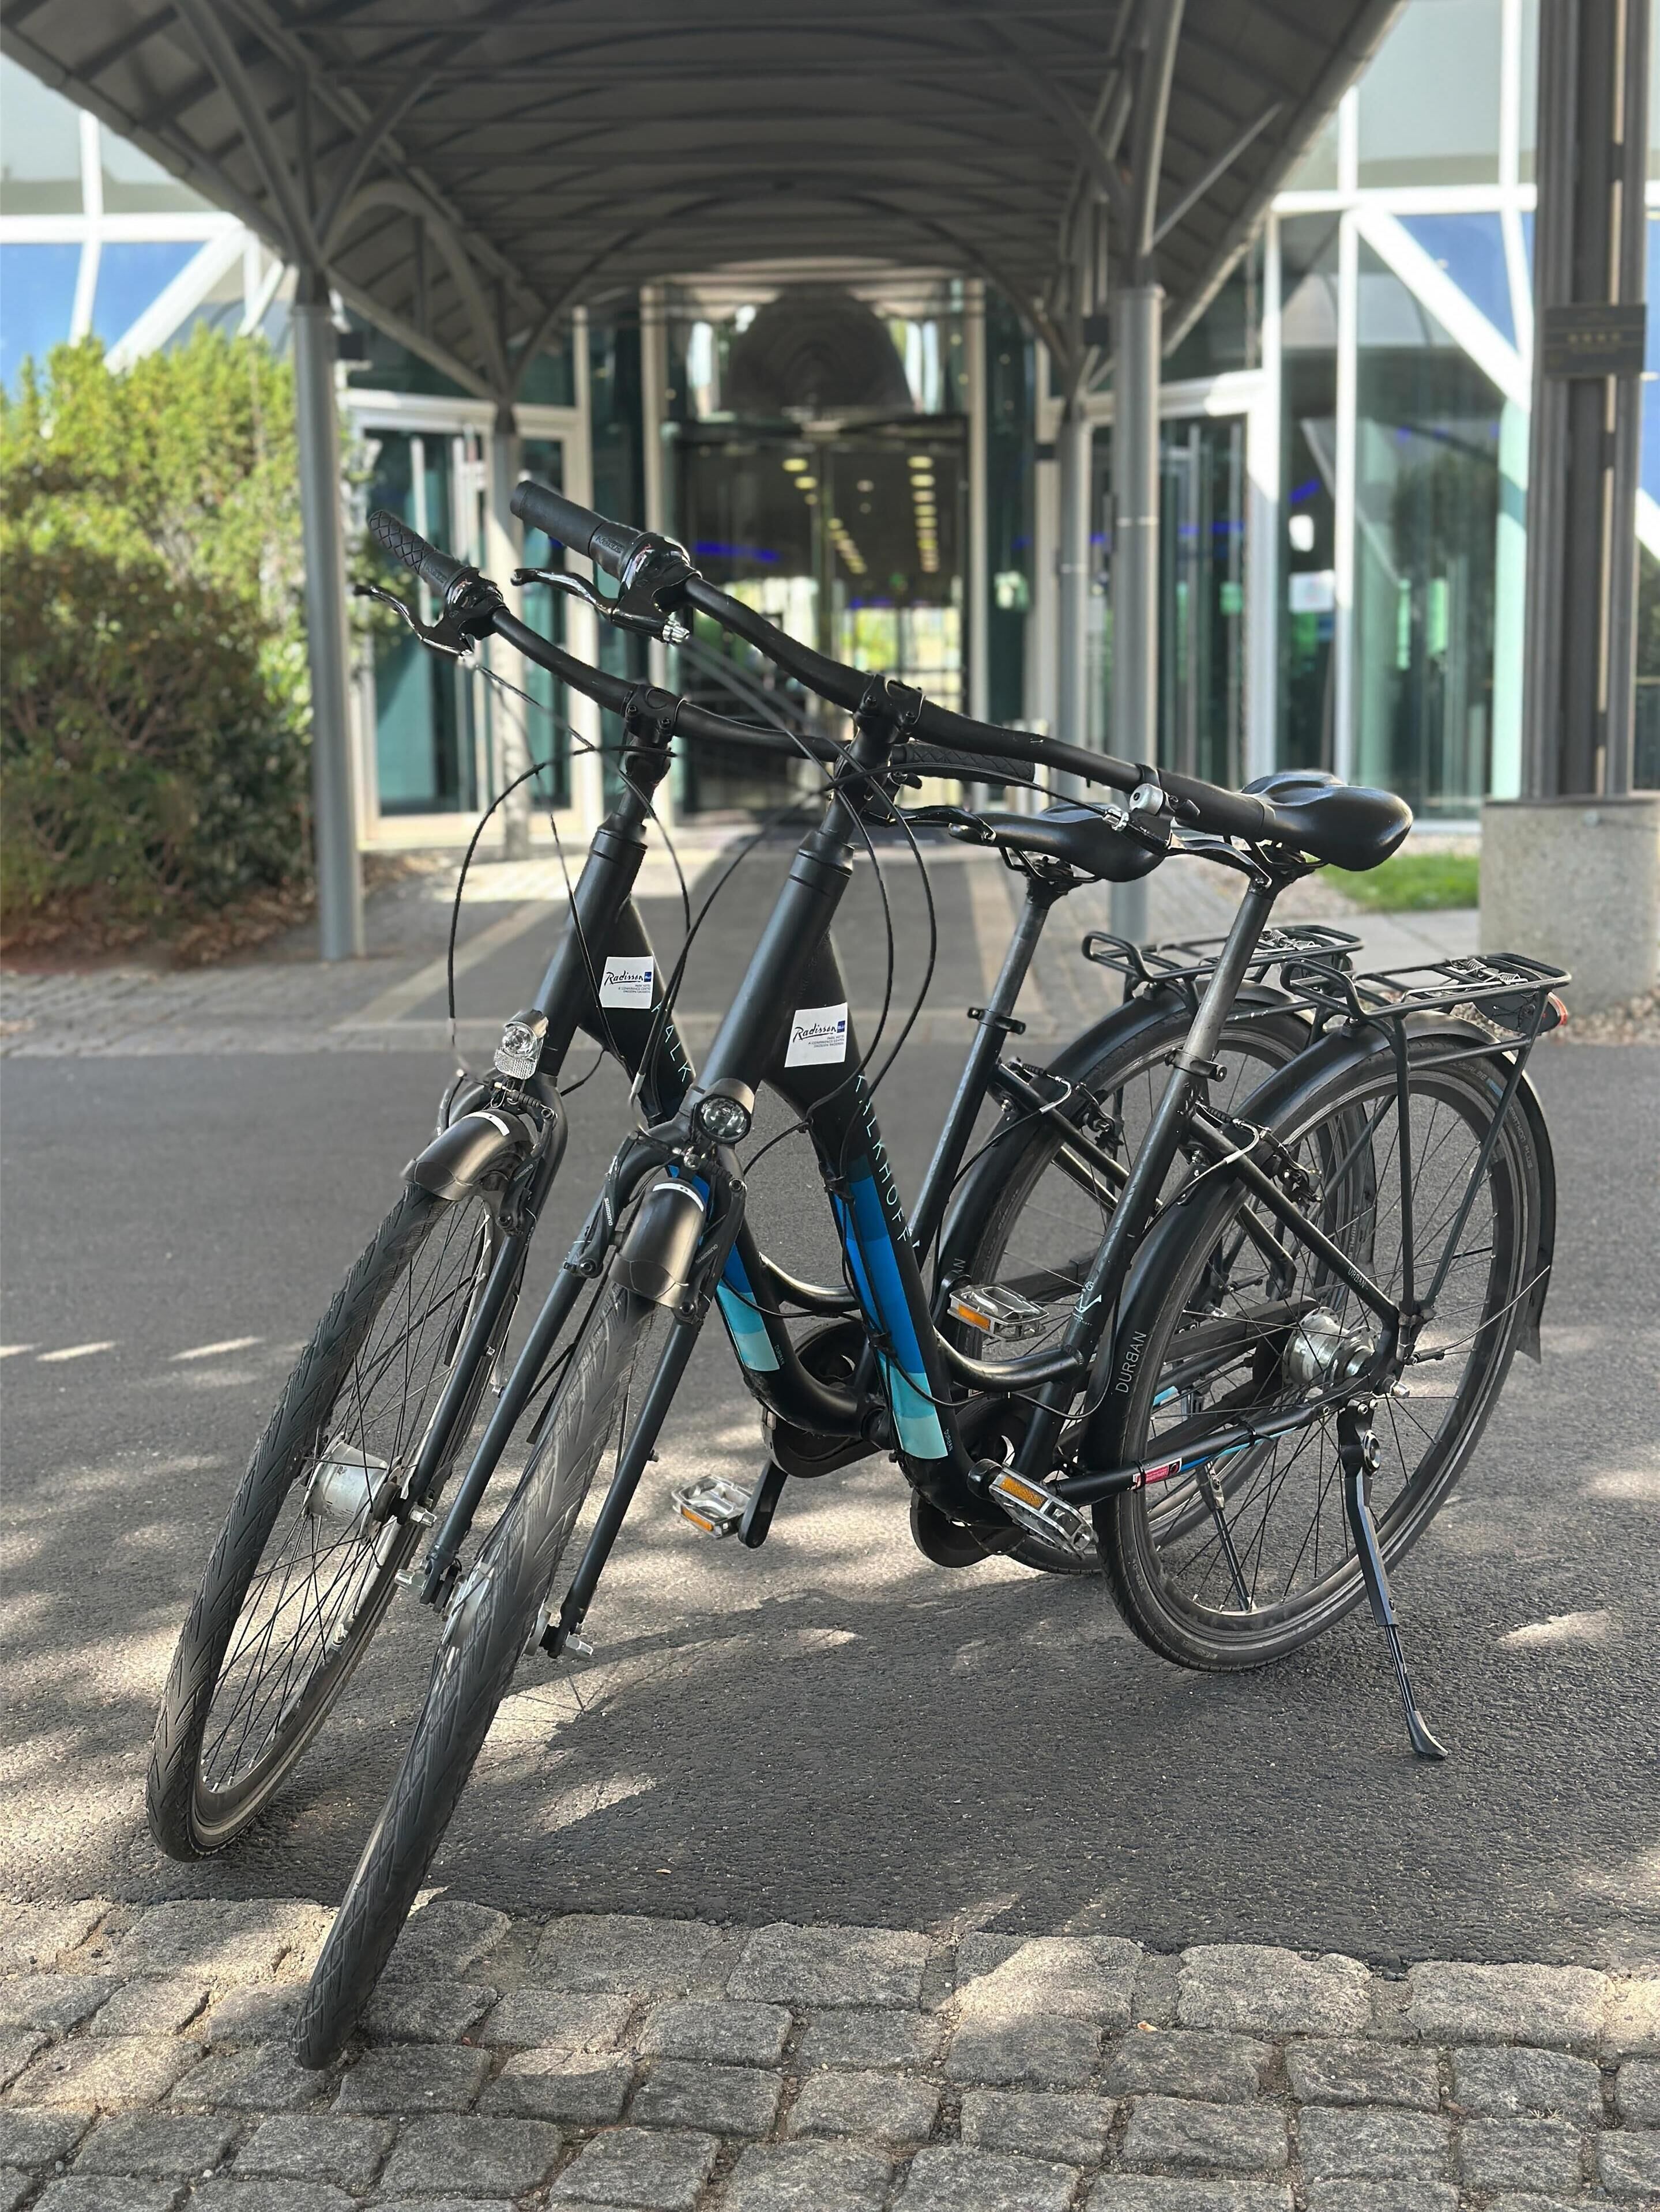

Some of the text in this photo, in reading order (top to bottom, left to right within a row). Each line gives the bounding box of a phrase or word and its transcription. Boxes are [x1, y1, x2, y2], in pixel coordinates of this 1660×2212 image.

[604, 970, 644, 986] Radisson
[792, 1023, 836, 1043] Radisson
[604, 1197, 613, 1226] SHIMANO
[1115, 1331, 1147, 1393] DURBAN
